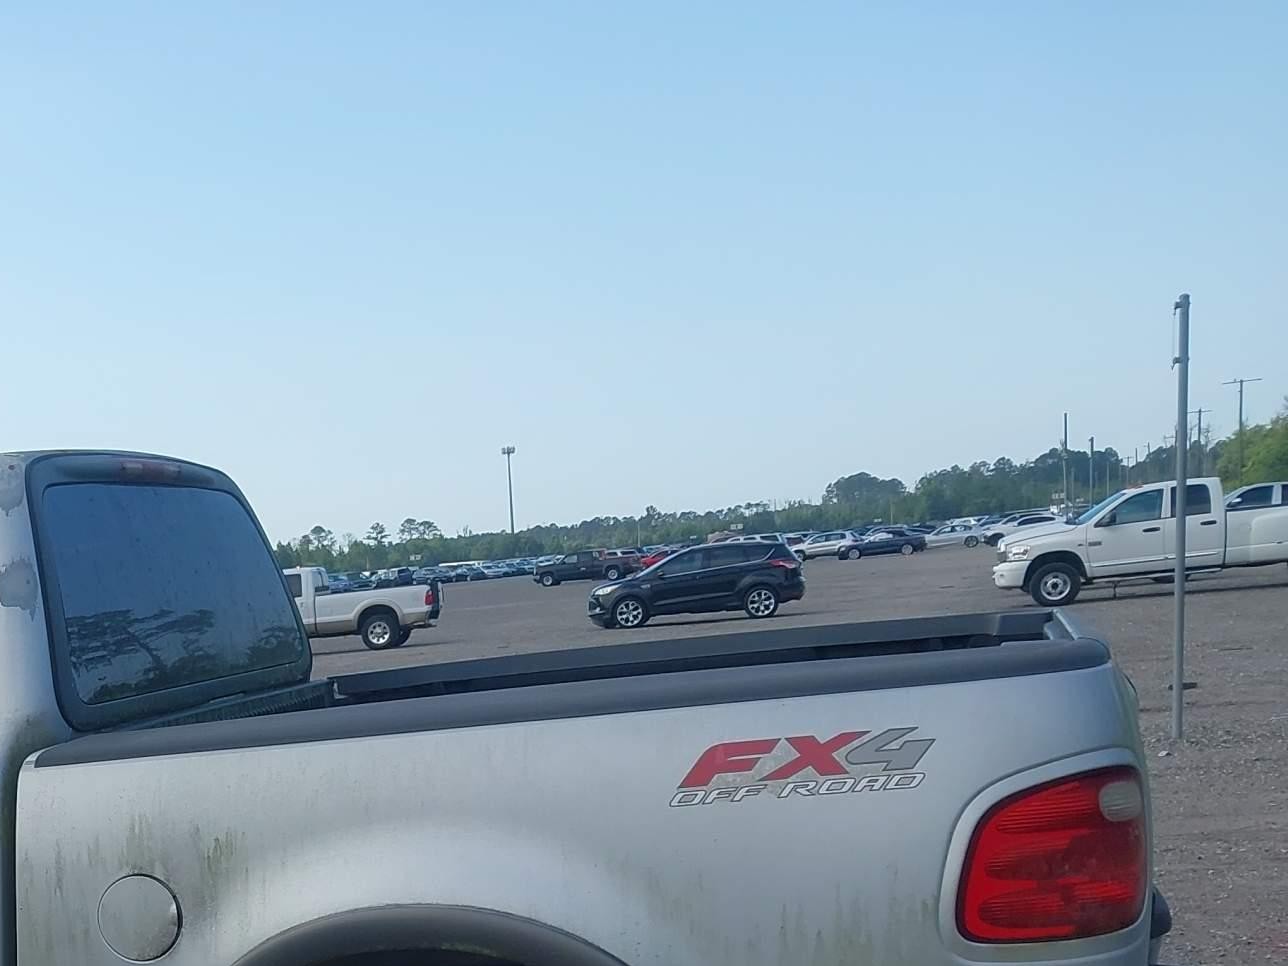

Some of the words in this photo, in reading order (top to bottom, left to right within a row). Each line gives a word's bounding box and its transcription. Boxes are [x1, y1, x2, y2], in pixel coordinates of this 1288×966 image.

[677, 726, 936, 789] FX4
[668, 783, 767, 808] OFF
[776, 771, 926, 799] ROAD
